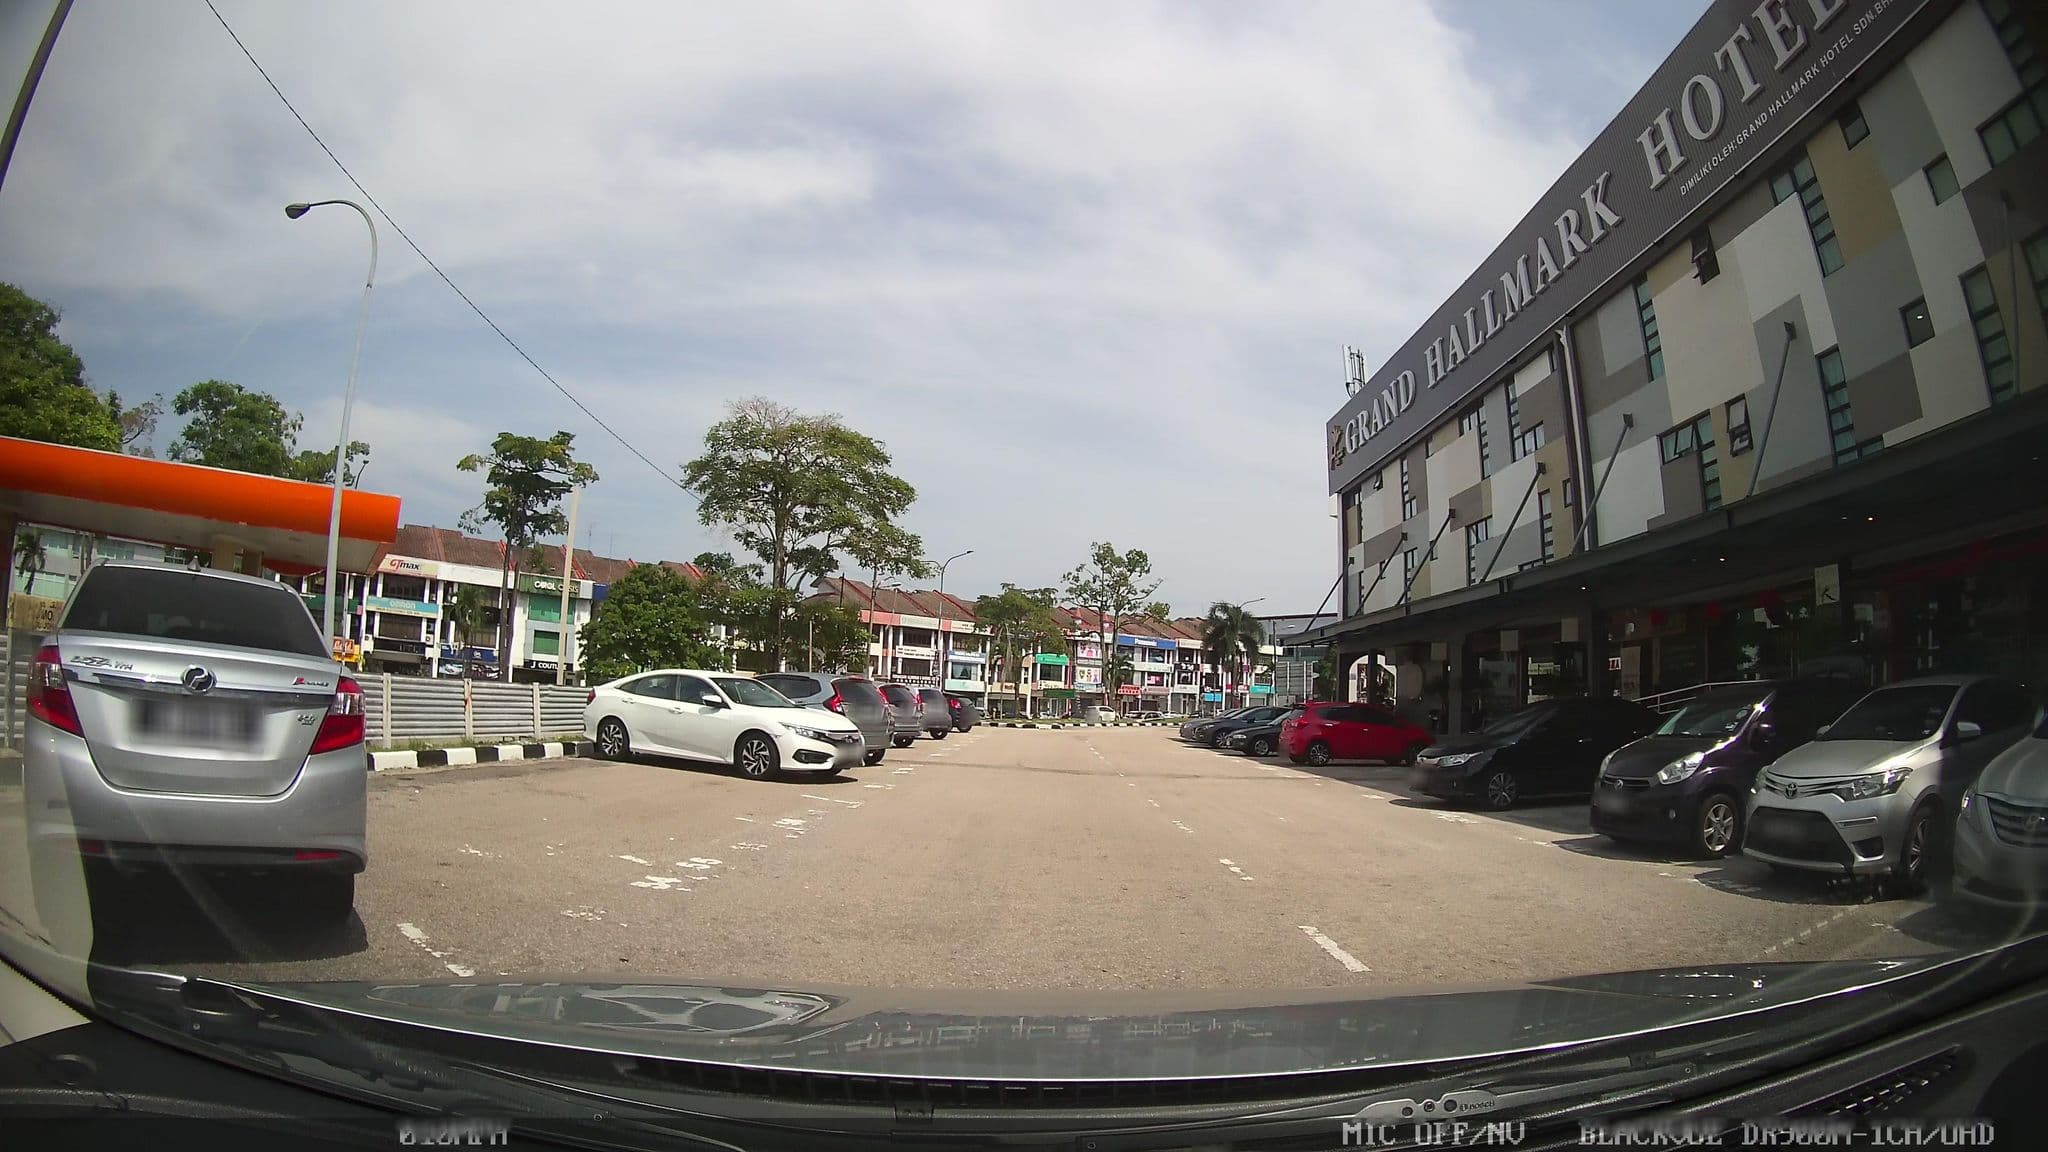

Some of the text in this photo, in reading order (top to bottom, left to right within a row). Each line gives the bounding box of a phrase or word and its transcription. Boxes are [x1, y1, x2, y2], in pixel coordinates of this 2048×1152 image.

[1767, 63, 1820, 116] HALLMARK
[1820, 33, 1854, 67] HOTEL
[1345, 369, 1416, 454] GRAND
[1424, 171, 1622, 388] HALLMARK
